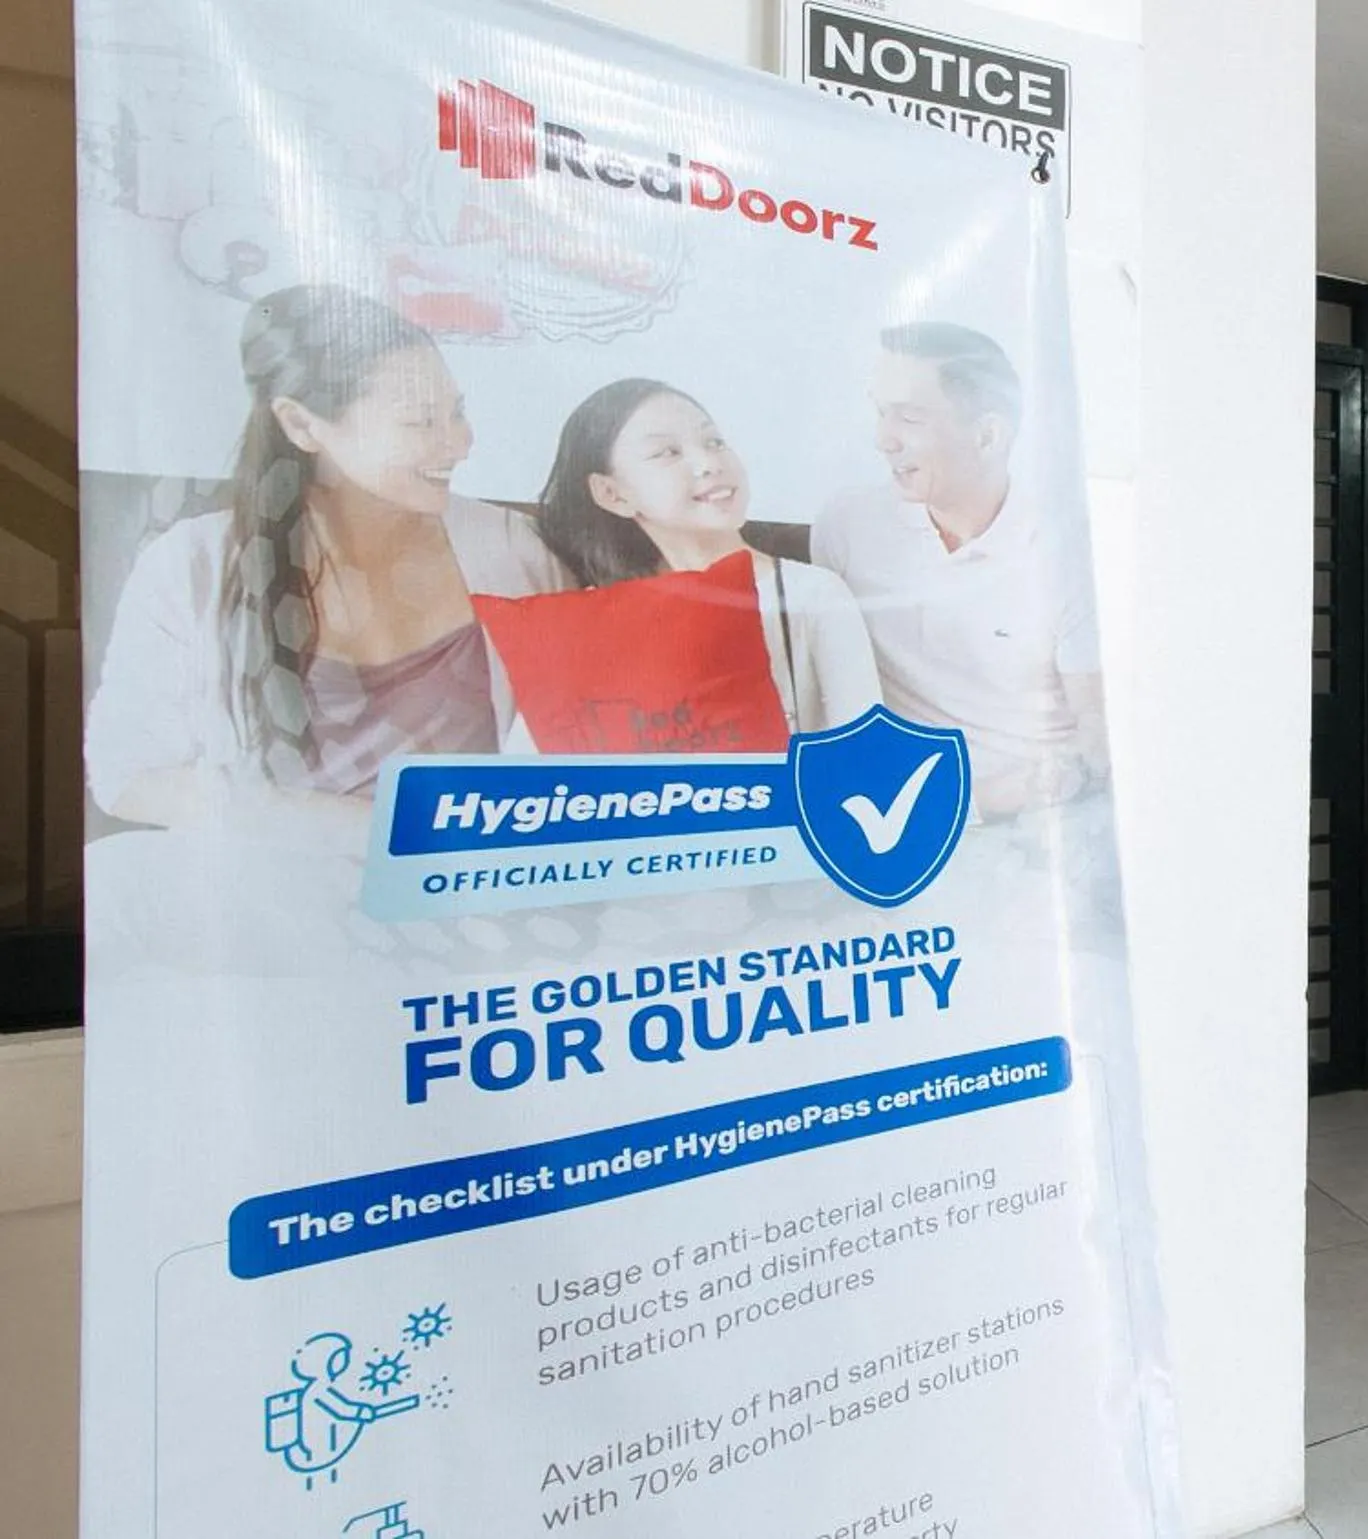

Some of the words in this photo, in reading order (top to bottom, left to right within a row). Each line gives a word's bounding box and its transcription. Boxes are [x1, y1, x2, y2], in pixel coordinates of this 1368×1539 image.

[823, 25, 1052, 116] NOTICE
[543, 121, 879, 251] RedDoorz
[422, 860, 613, 895] OFFICIALLY
[625, 846, 777, 875] CERTIFIED
[431, 781, 772, 835] HygienePass
[402, 986, 518, 1032] THE
[531, 957, 726, 1014] GOLDEN
[739, 926, 956, 982] STANDARD
[404, 1017, 605, 1106] FOR
[628, 958, 963, 1065] QUALITY
[268, 1208, 356, 1249] The
[363, 1165, 556, 1224] checklist
[562, 1142, 670, 1187] under
[674, 1094, 874, 1161] HygienePass
[876, 1060, 1051, 1112] certification:
[536, 1260, 642, 1308] Usage
[653, 1246, 685, 1278] of
[692, 1192, 885, 1266] anti-bacterial
[890, 1165, 997, 1212] cleaning
[537, 1287, 690, 1352] products
[699, 1264, 754, 1301] and
[760, 1211, 940, 1280] disinfectants
[945, 1199, 983, 1230] for
[985, 1179, 1069, 1219] regular
[538, 1318, 707, 1387] sanitation
[715, 1266, 876, 1339] procedures
[540, 1413, 724, 1492] Availability
[730, 1394, 761, 1428] of
[768, 1370, 840, 1413] hand
[847, 1331, 960, 1385] sanitizer
[967, 1298, 1065, 1345] stations
[542, 1486, 619, 1531] with
[632, 1459, 699, 1502] 70%
[707, 1384, 911, 1476] alcohol-based
[917, 1345, 1021, 1397] solution
